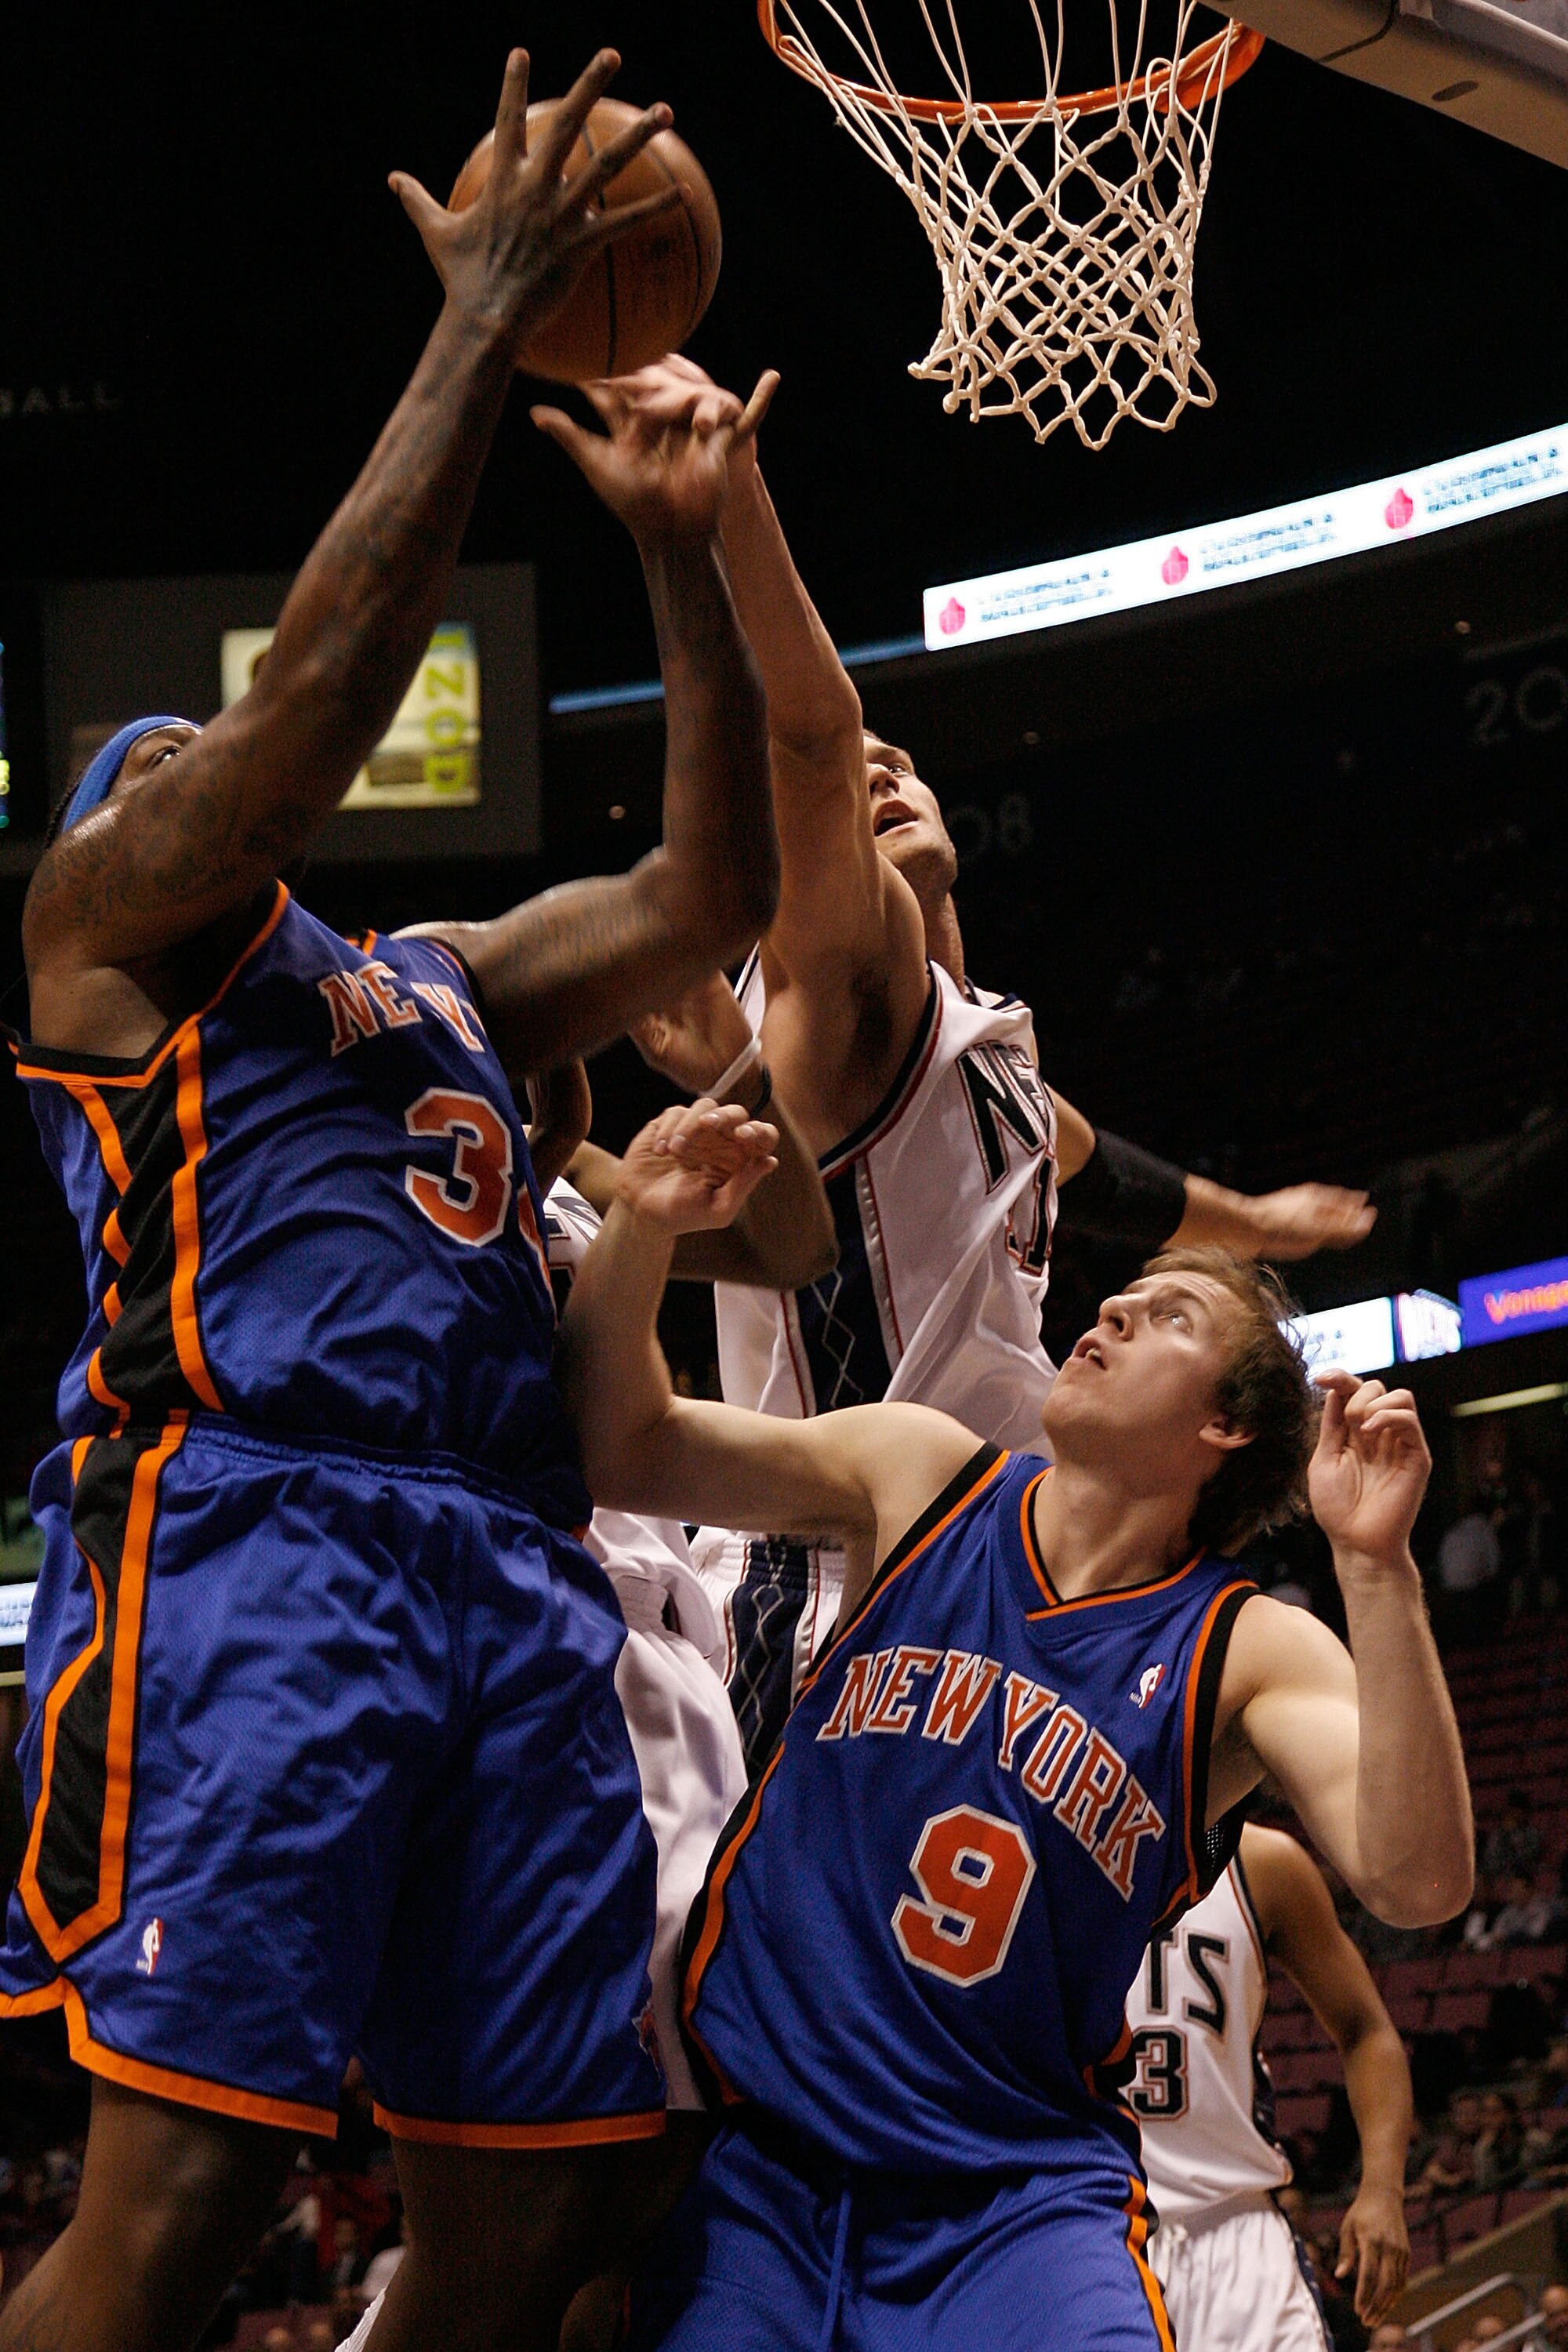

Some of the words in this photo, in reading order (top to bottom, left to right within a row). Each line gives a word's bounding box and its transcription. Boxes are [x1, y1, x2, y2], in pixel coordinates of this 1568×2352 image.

[815, 1644, 1004, 1746] NEW
[997, 1671, 1167, 1904] YORK
[891, 1803, 1037, 1988] 9
